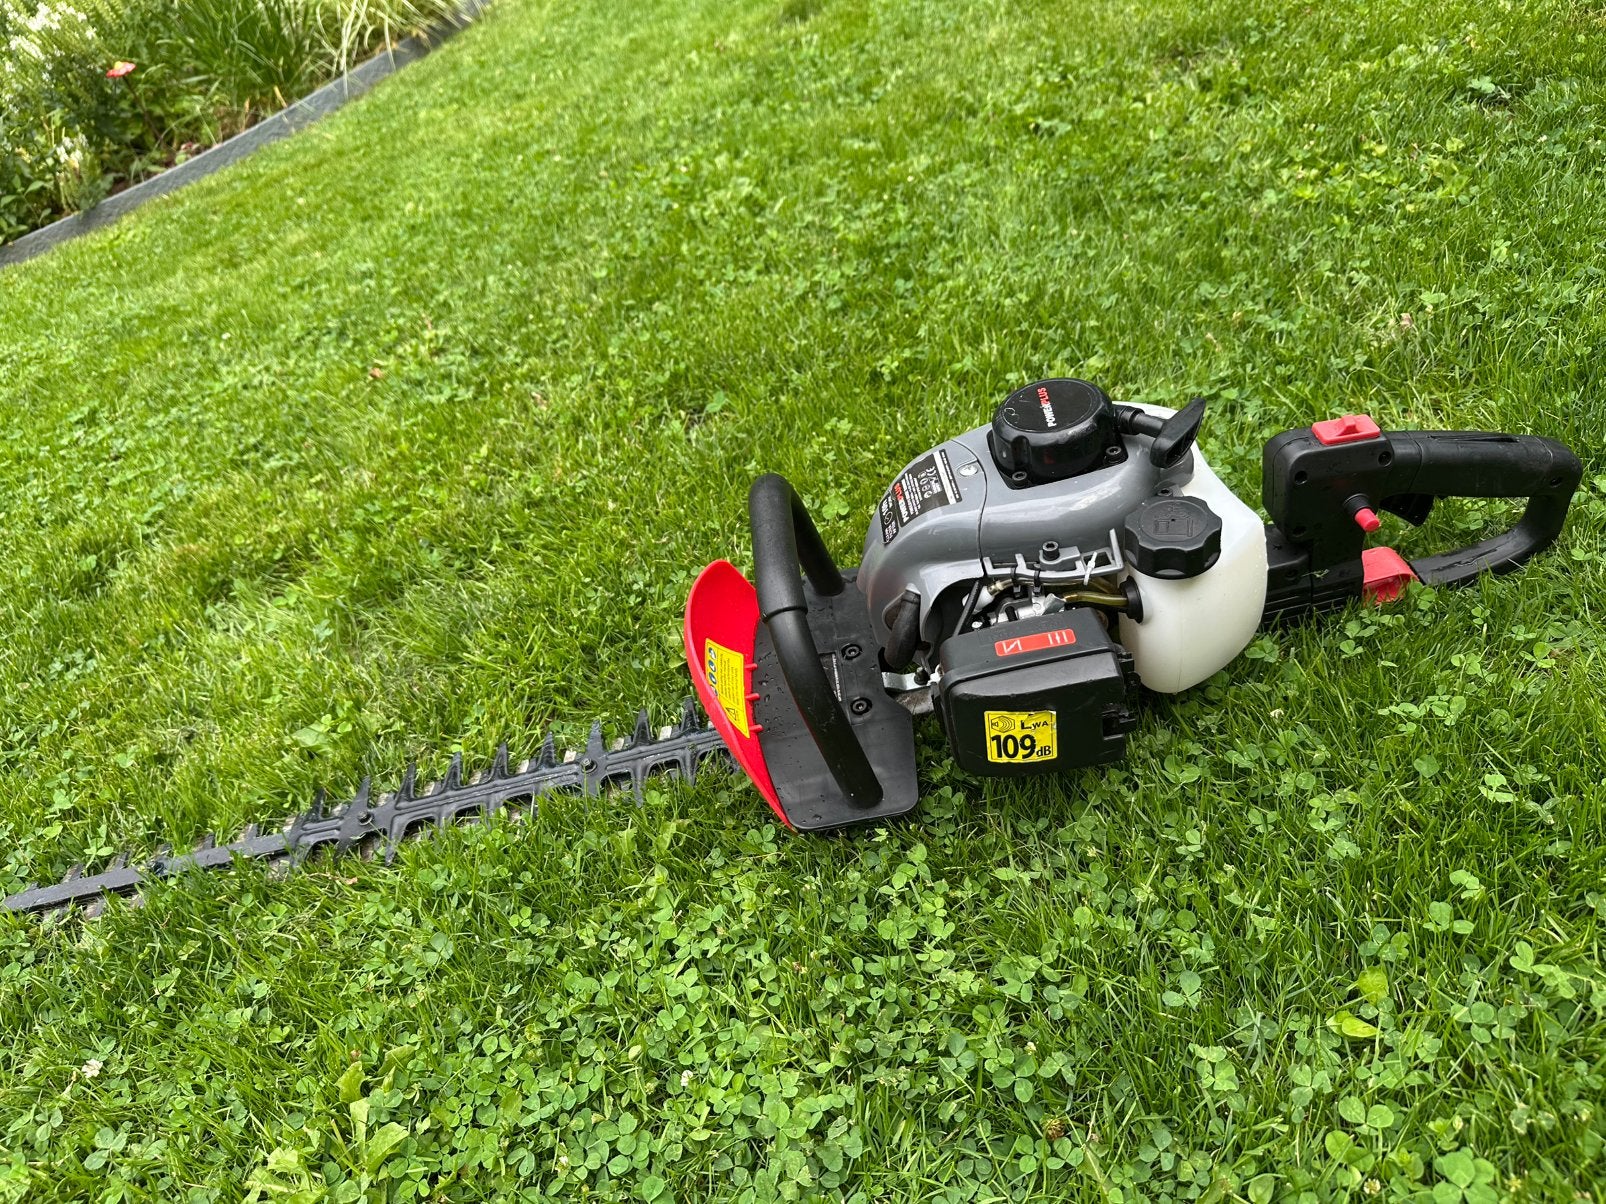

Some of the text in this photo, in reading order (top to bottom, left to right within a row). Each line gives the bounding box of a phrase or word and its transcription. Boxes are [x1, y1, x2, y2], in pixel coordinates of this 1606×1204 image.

[1037, 387, 1057, 428] POWERPLUS
[894, 482, 910, 523] POWERPLUS
[991, 734, 1052, 760] 109 dB
